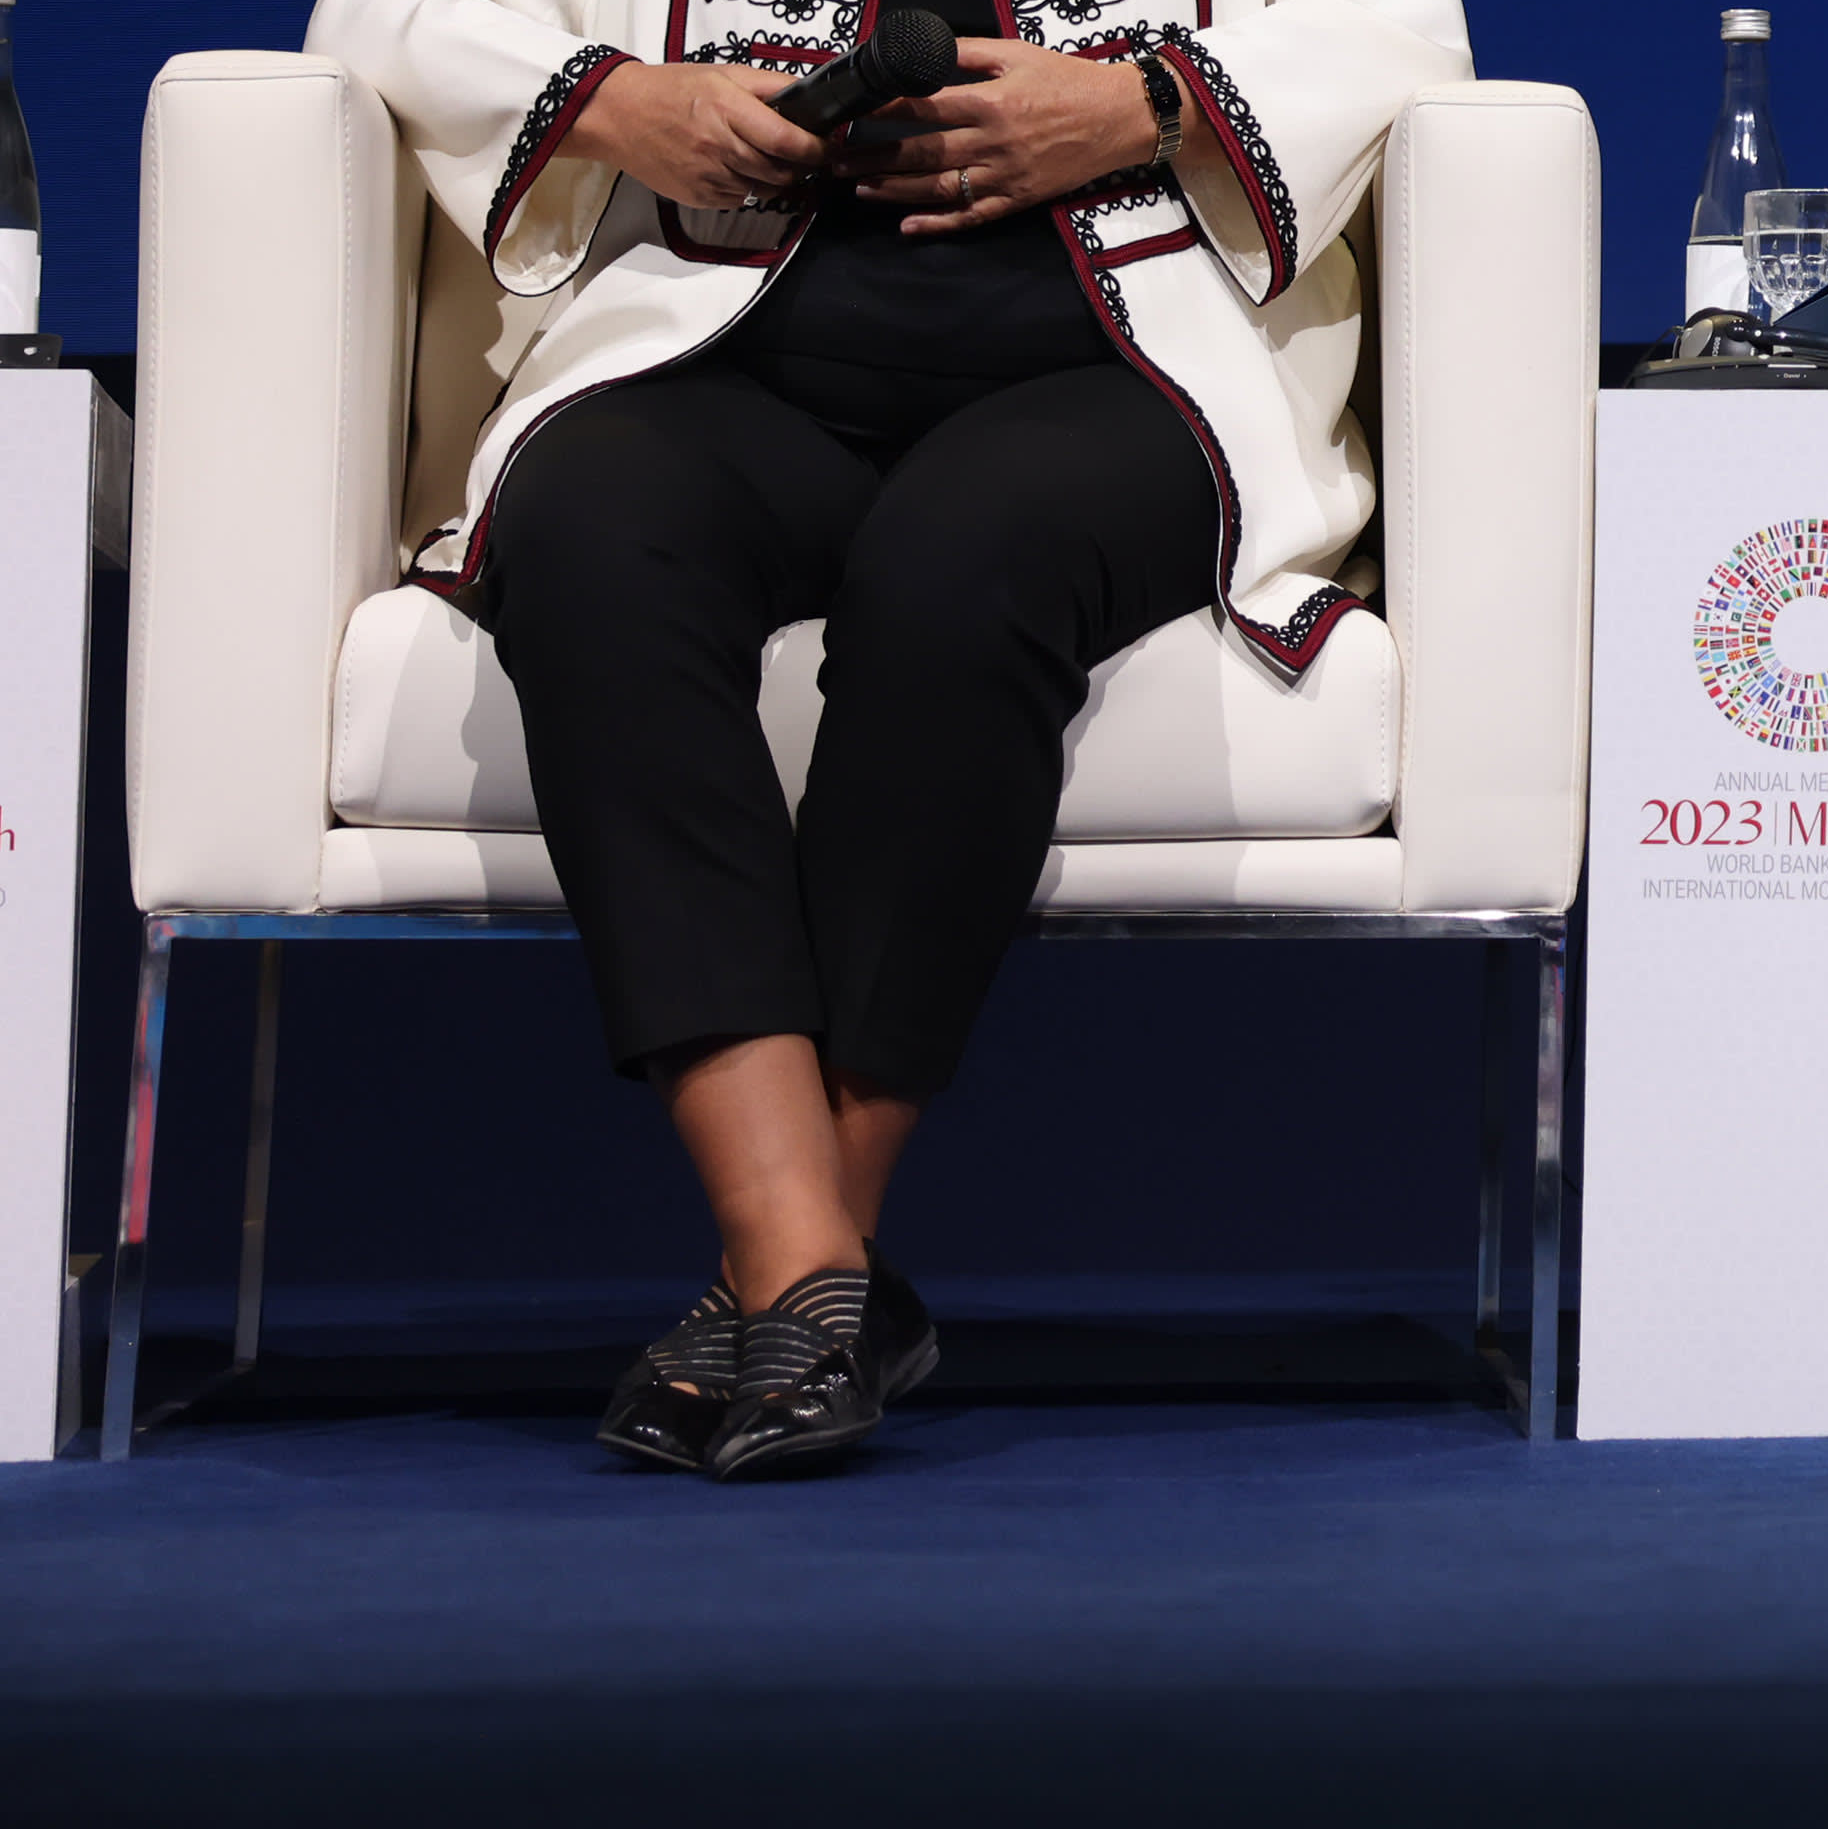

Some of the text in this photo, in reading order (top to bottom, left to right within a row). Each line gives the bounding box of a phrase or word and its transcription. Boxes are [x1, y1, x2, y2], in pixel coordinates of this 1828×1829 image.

[1714, 772, 1796, 792] ANNUAL
[1639, 798, 1764, 847] 2023
[1706, 854, 1775, 874] WORLD
[1643, 878, 1796, 900] INTERNATIONAL
